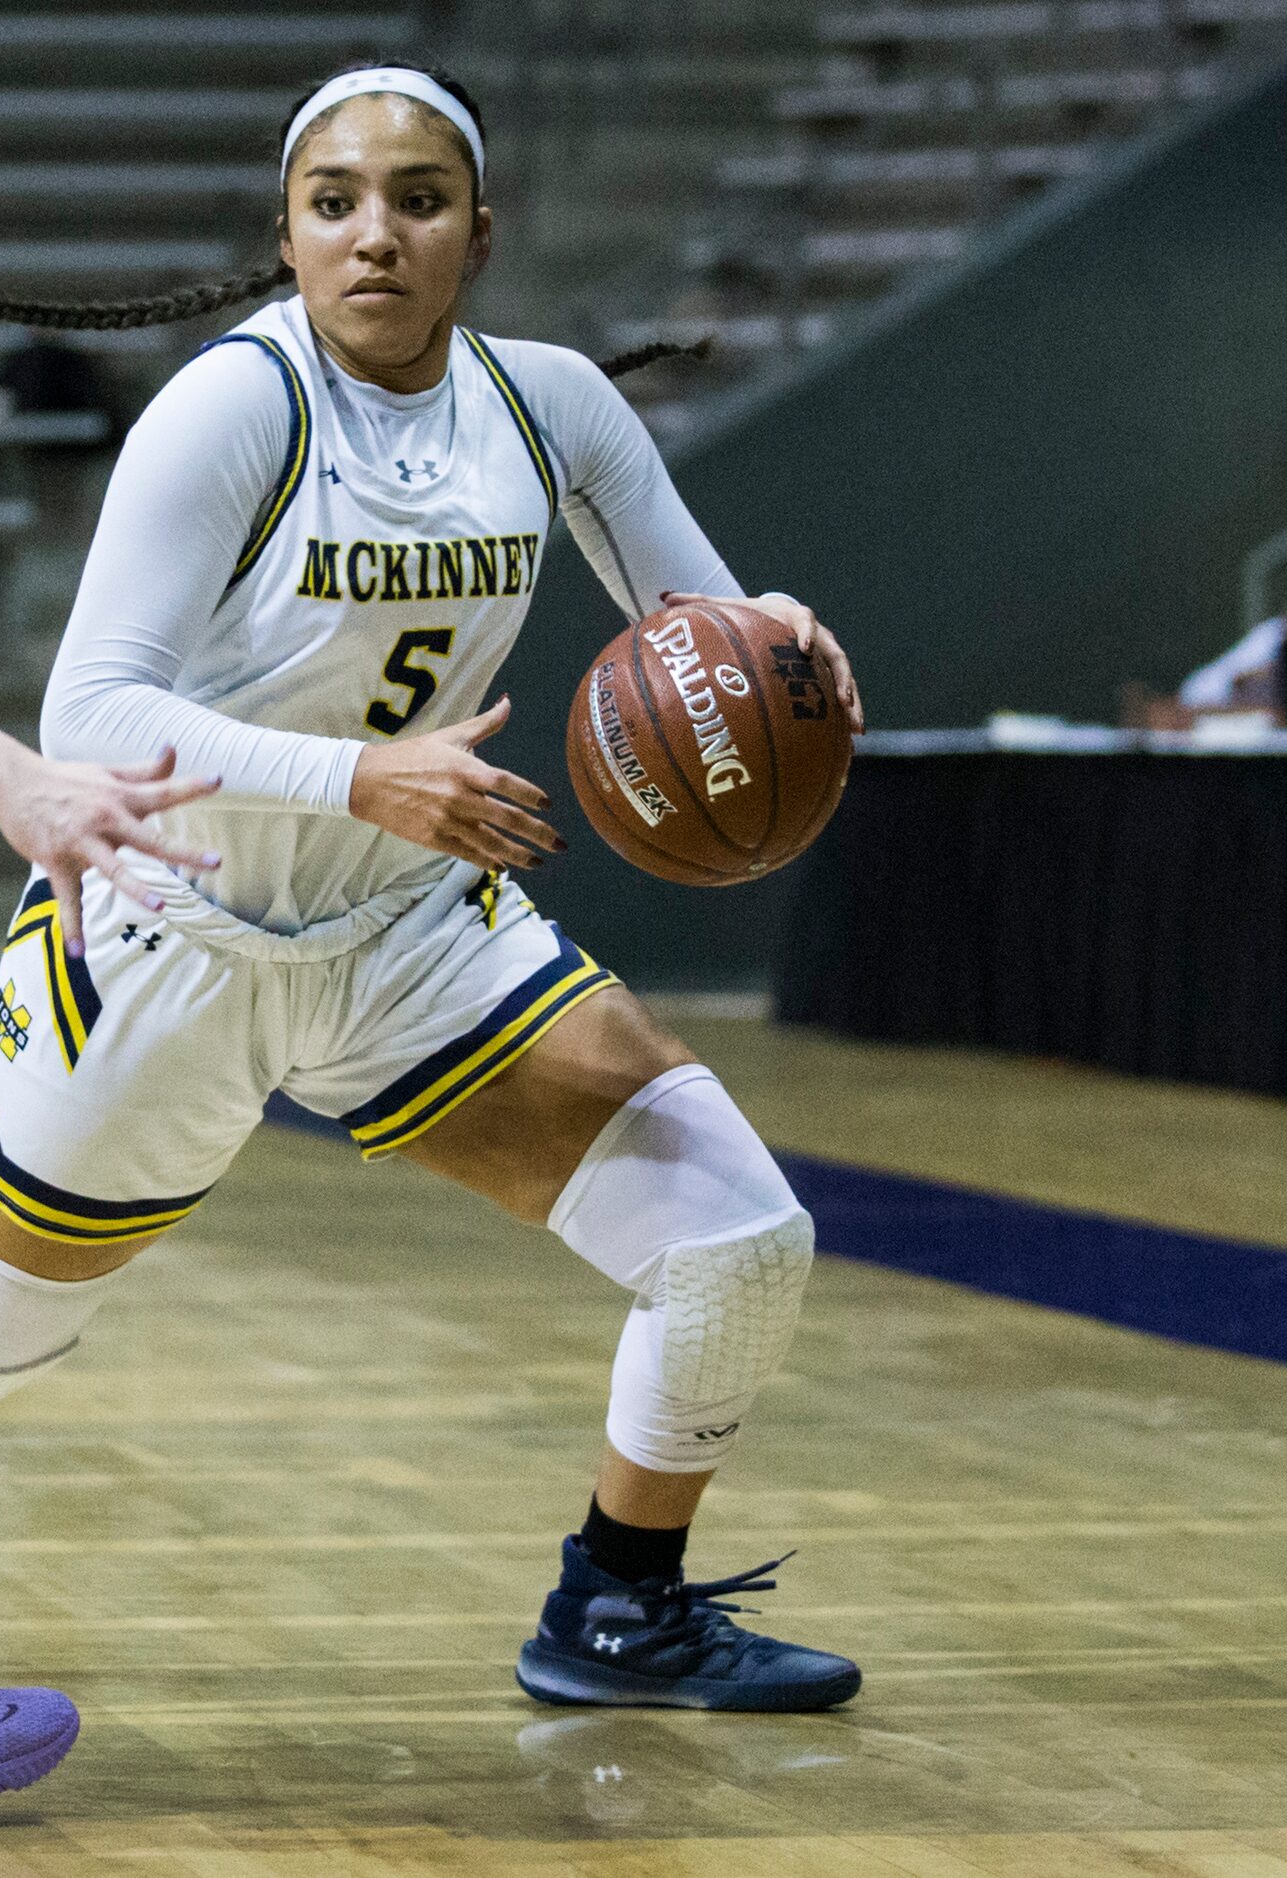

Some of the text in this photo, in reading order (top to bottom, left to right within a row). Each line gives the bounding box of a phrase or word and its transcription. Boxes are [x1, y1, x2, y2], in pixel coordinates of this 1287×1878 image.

[297, 534, 539, 602] MCKINNEY
[364, 626, 456, 738] 5
[597, 661, 648, 784] PLATINUM
[644, 617, 752, 798] SPALDING
